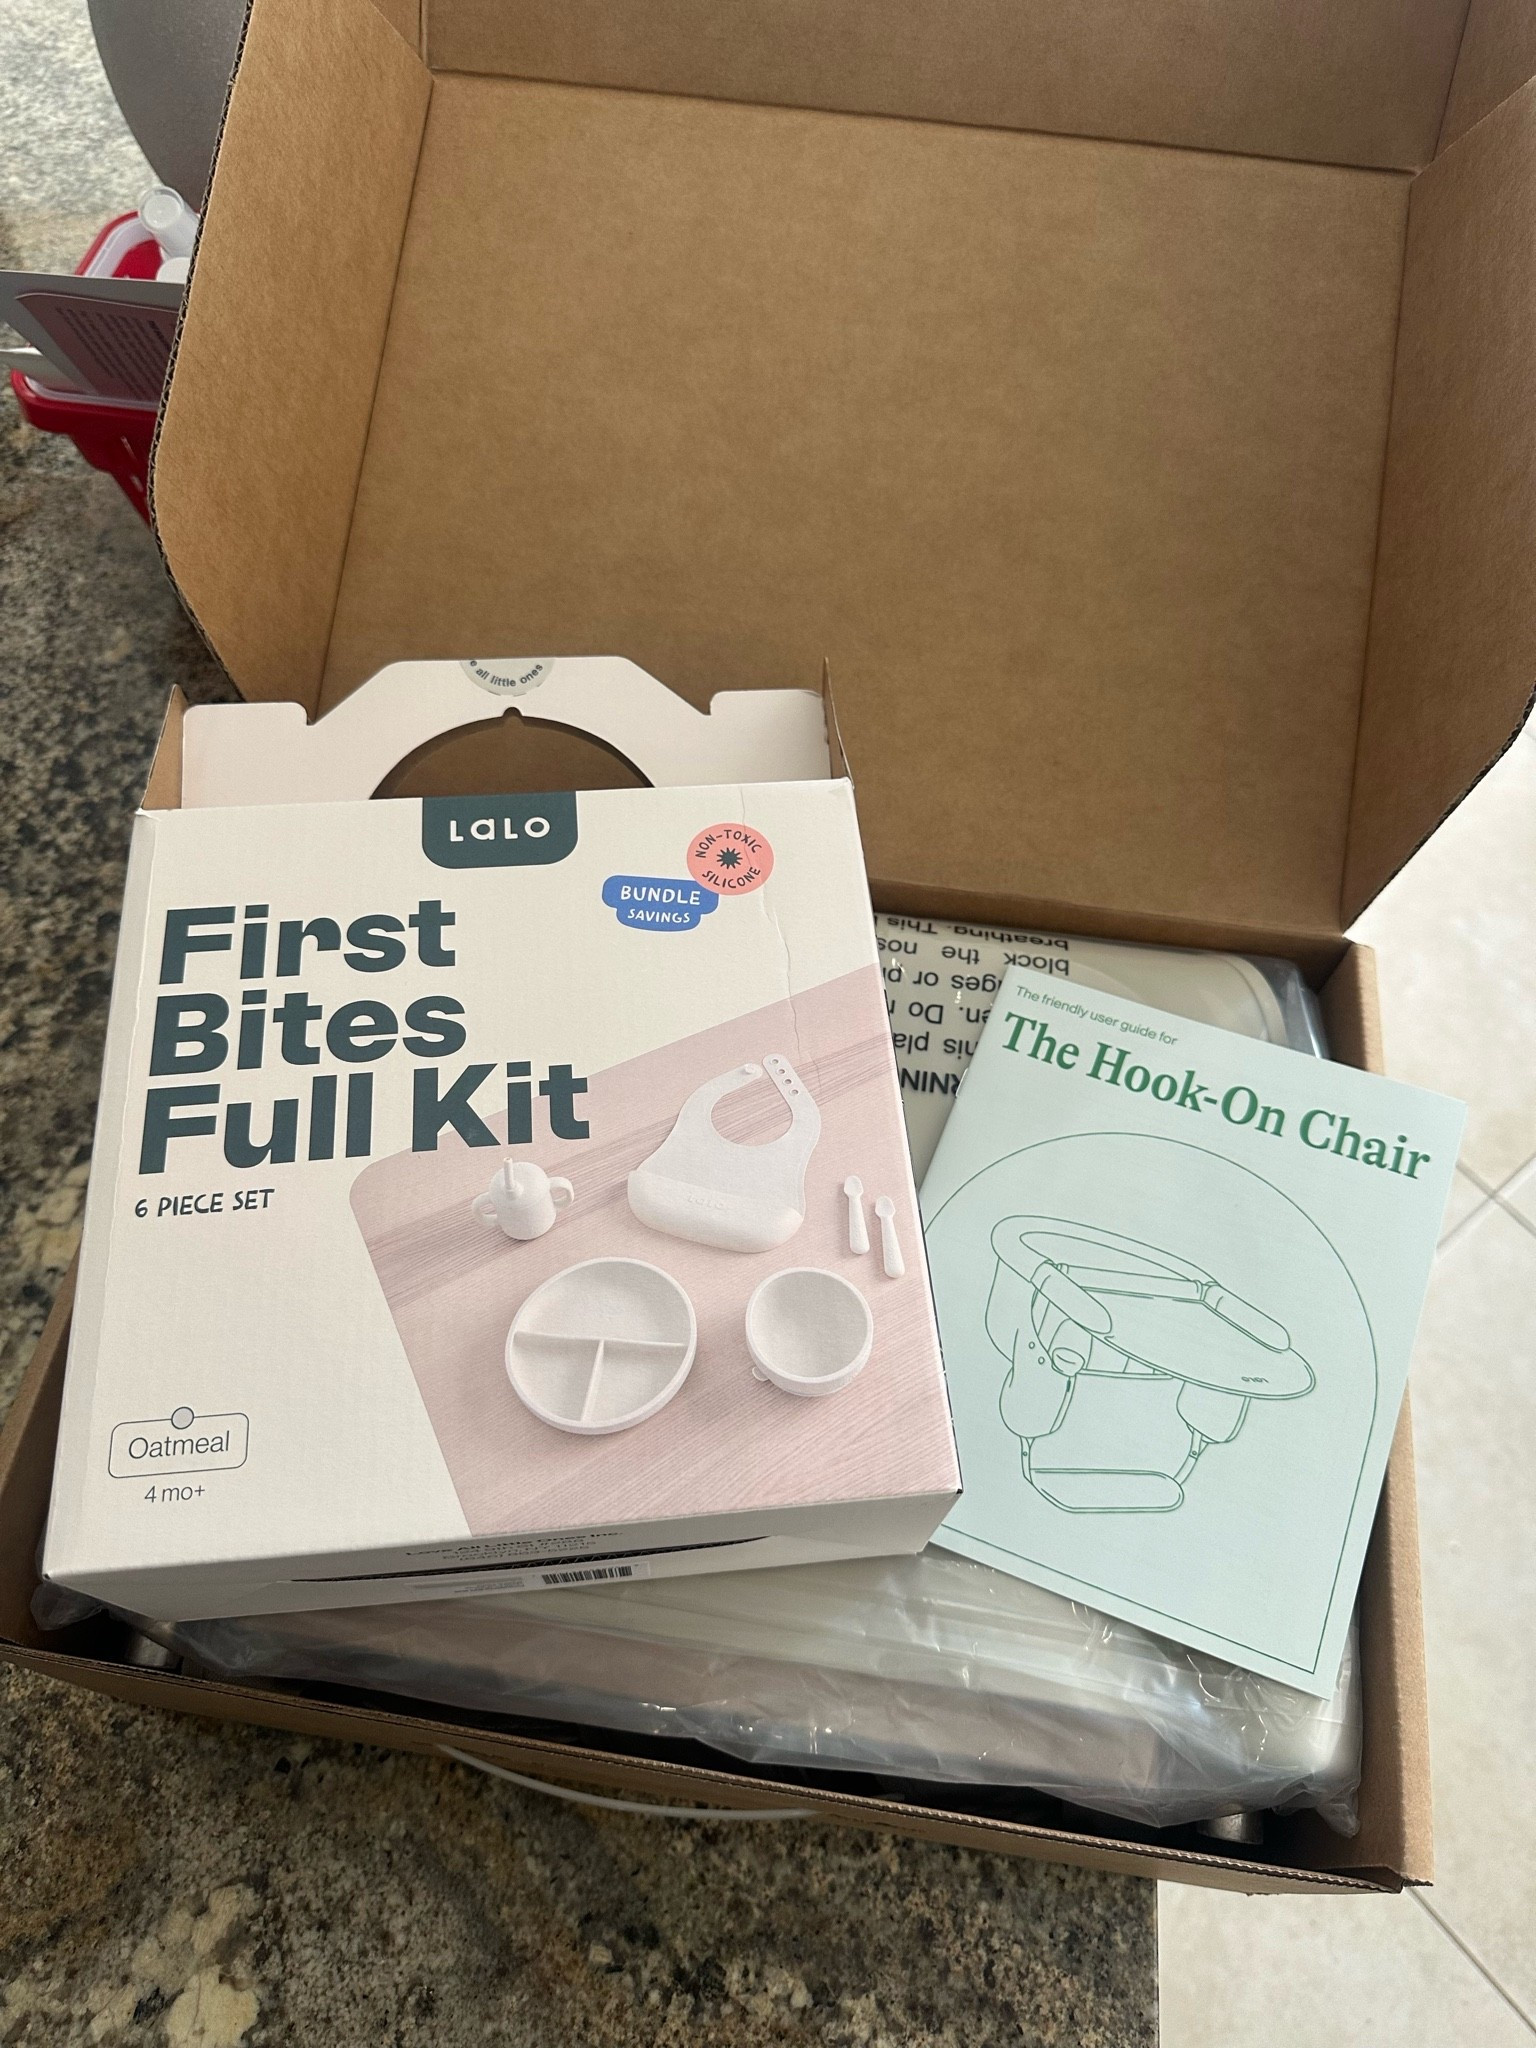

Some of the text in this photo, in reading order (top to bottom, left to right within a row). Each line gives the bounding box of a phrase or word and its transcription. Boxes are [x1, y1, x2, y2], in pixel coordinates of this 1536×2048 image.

[476, 664, 544, 687] all little ones
[694, 828, 763, 859] NON-TOXIC
[701, 866, 761, 889] SILICONE
[620, 885, 701, 906] BUNDLE
[626, 908, 691, 924] SAVINGS
[886, 916, 938, 935] This
[159, 899, 456, 985] First
[947, 925, 1069, 951] breathing.
[877, 939, 1069, 976] block the nos
[912, 971, 939, 987] or
[908, 1001, 944, 1024] Do
[1015, 984, 1179, 1047] The friendly user guide for
[149, 988, 467, 1077] Bites
[1002, 1012, 1431, 1180] The Hook-On Chair
[138, 1060, 591, 1175] Full Kit
[134, 1187, 276, 1218] 6 PIECE SET
[128, 1430, 230, 1460] Oatmeal
[144, 1484, 206, 1503] 4 mo+
